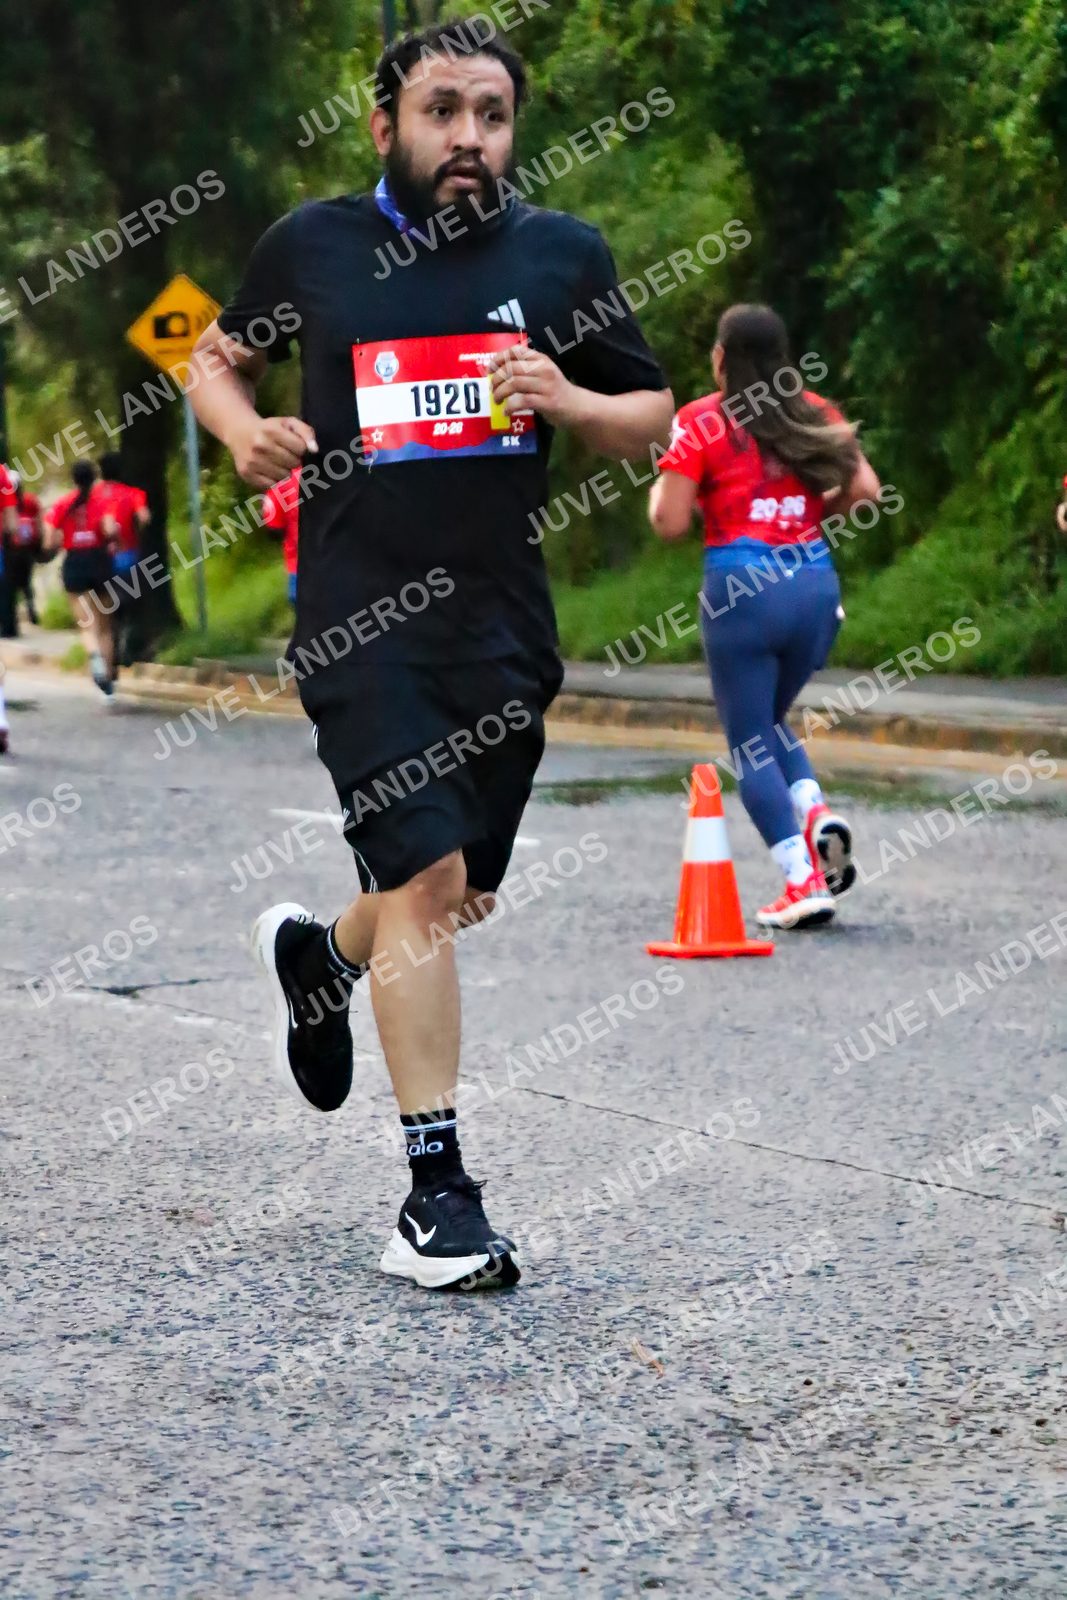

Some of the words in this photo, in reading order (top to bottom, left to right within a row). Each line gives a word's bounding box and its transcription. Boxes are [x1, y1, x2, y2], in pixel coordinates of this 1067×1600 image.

[411, 381, 482, 417] 1920
[502, 435, 520, 447] 5K
[408, 1133, 443, 1155] alo
